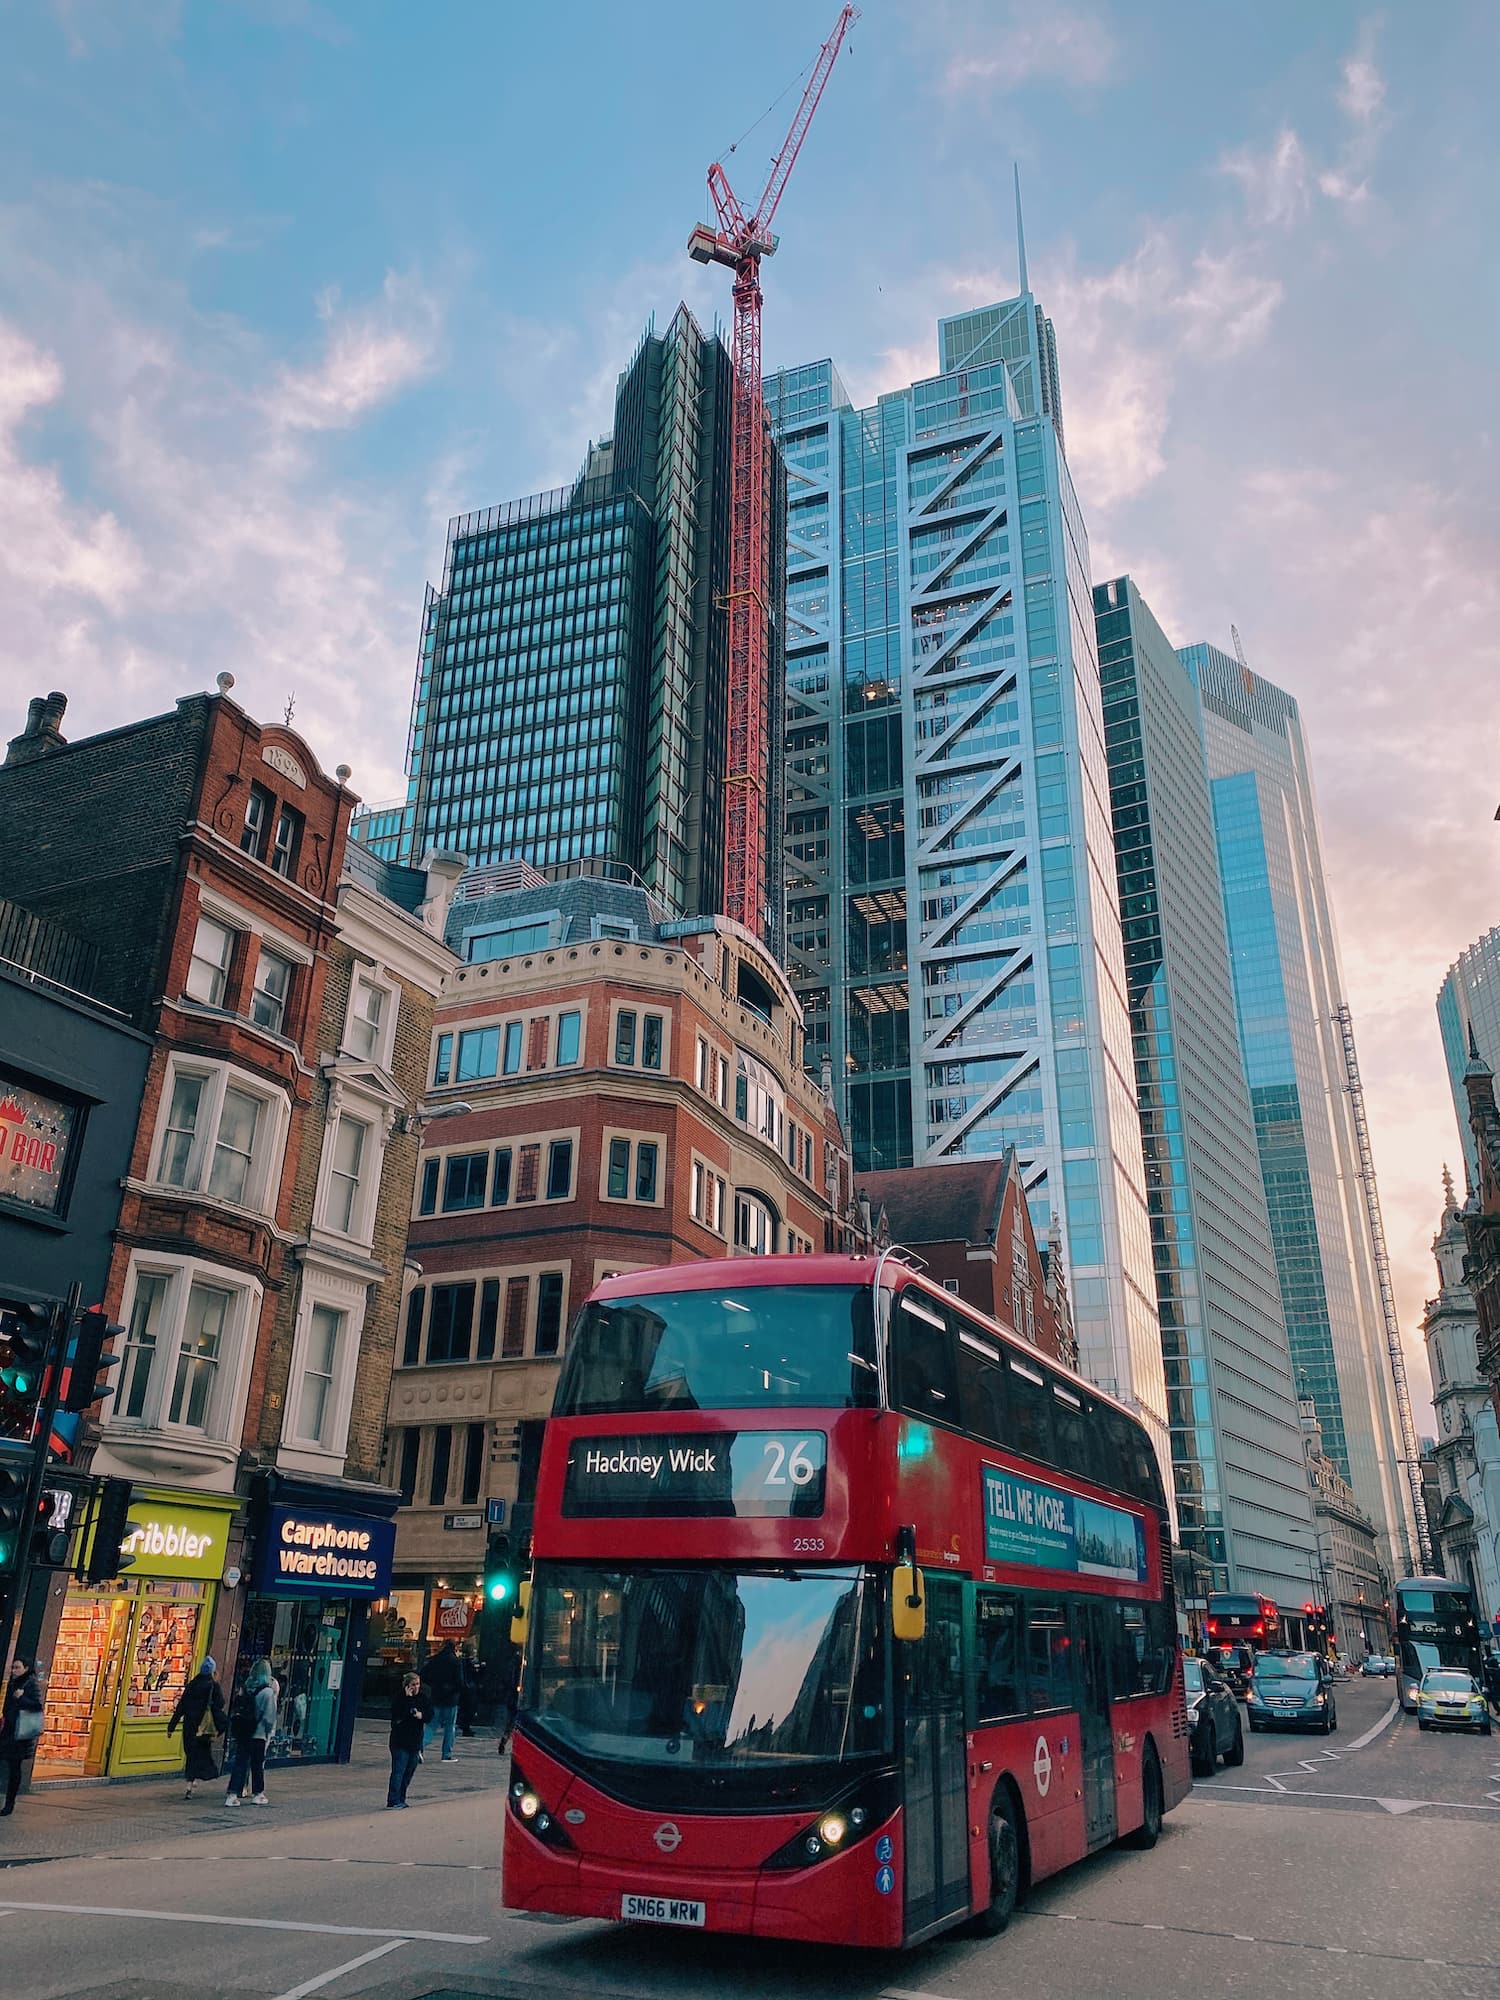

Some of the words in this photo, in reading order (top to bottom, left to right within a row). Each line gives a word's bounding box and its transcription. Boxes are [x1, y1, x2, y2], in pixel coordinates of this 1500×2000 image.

[10, 1131, 57, 1174] BAR
[586, 1450, 664, 1479] Hackney
[669, 1448, 717, 1473] Wick
[763, 1440, 814, 1486] 26
[987, 1478, 1015, 1522] TELL
[1016, 1487, 1033, 1525] ME
[118, 1522, 212, 1558] ribbler
[281, 1520, 370, 1551] Carphone
[793, 1538, 825, 1552] 2533
[280, 1550, 377, 1579] Warehouse
[1454, 1625, 1462, 1636] 8
[628, 1897, 665, 1917] SN66
[670, 1901, 699, 1921] WRW
